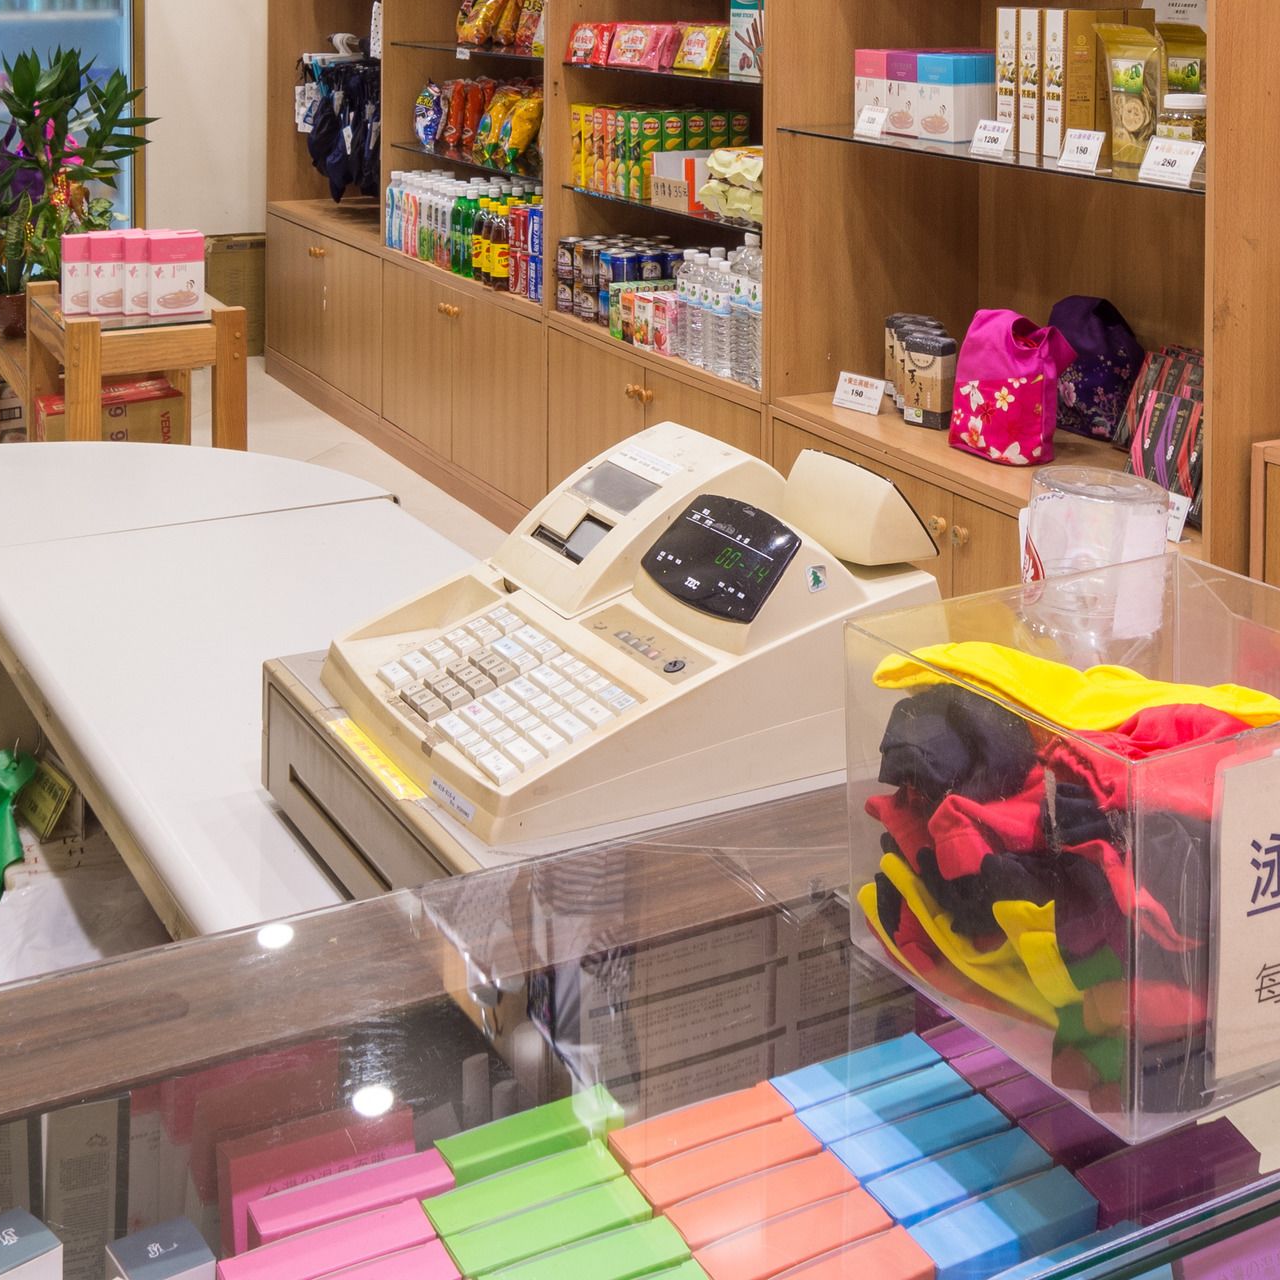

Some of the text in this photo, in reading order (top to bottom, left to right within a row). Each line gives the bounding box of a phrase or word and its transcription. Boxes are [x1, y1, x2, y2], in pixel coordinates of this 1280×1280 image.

[983, 134, 999, 145] 1200
[1161, 157, 1177, 168] 280
[850, 388, 864, 398] 180
